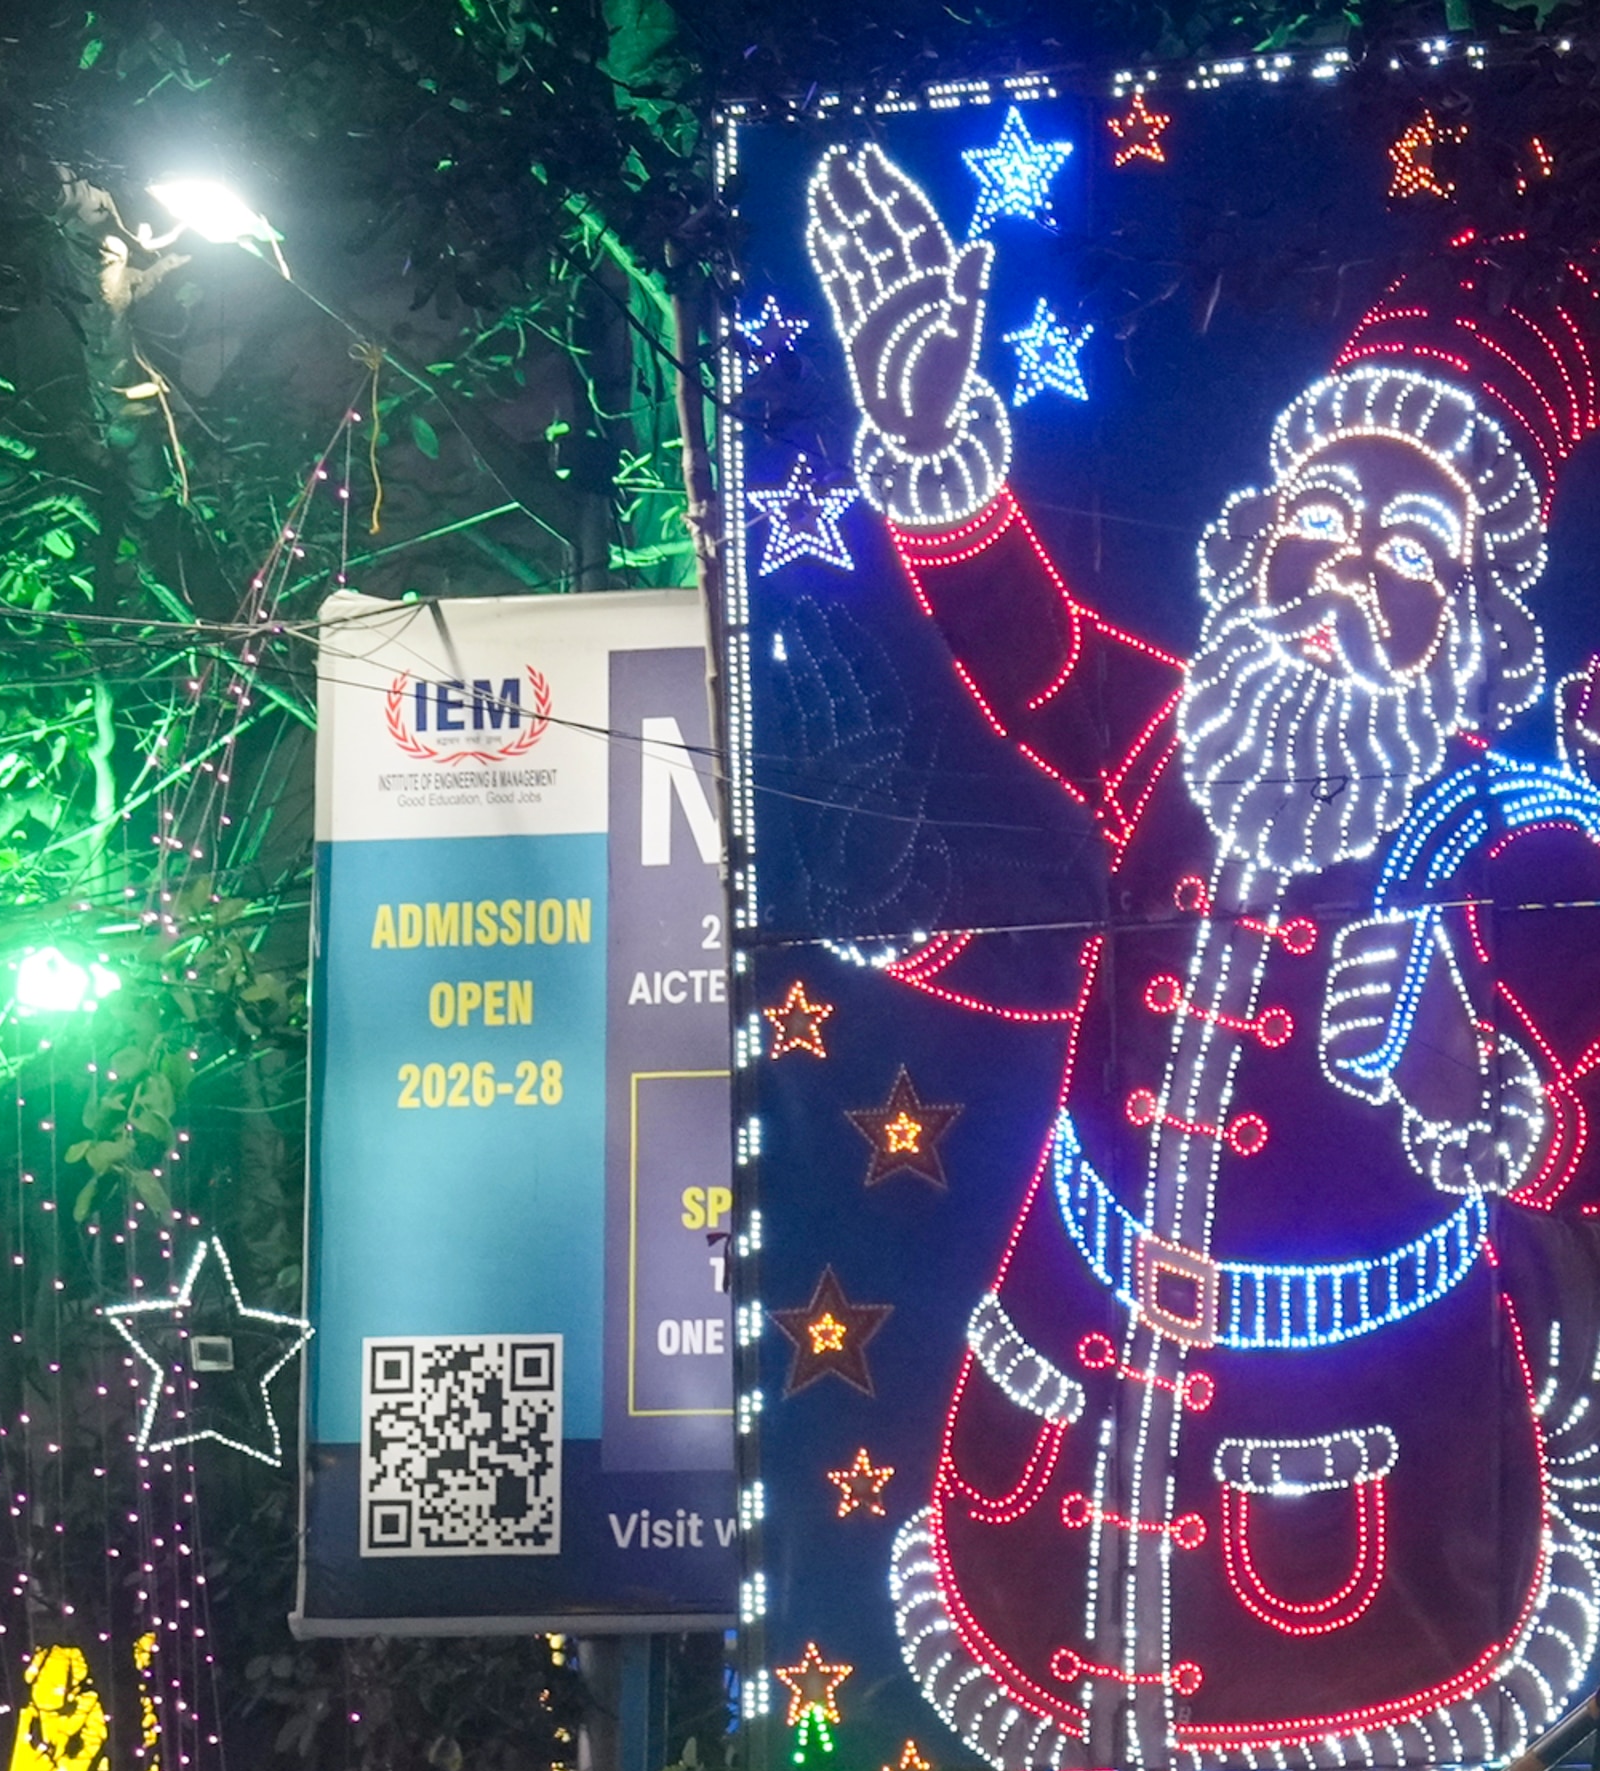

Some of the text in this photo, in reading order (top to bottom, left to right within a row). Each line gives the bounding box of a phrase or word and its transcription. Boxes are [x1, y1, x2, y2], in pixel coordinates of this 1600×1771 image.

[415, 678, 521, 732] IEM
[378, 774, 419, 791] INSTITUTE
[421, 772, 433, 790] OF
[434, 771, 490, 789] ENGINEERING
[500, 769, 557, 787] MANAGEMENT
[397, 790, 542, 808] Good Education, Good Jobs
[372, 898, 592, 949] ADMISSION
[702, 915, 721, 949] 2
[429, 980, 534, 1028] OPEN
[628, 969, 727, 1005] AICTE
[398, 1060, 563, 1108] 2026-28
[657, 1319, 724, 1355] ONE
[609, 1509, 703, 1548] Visit
